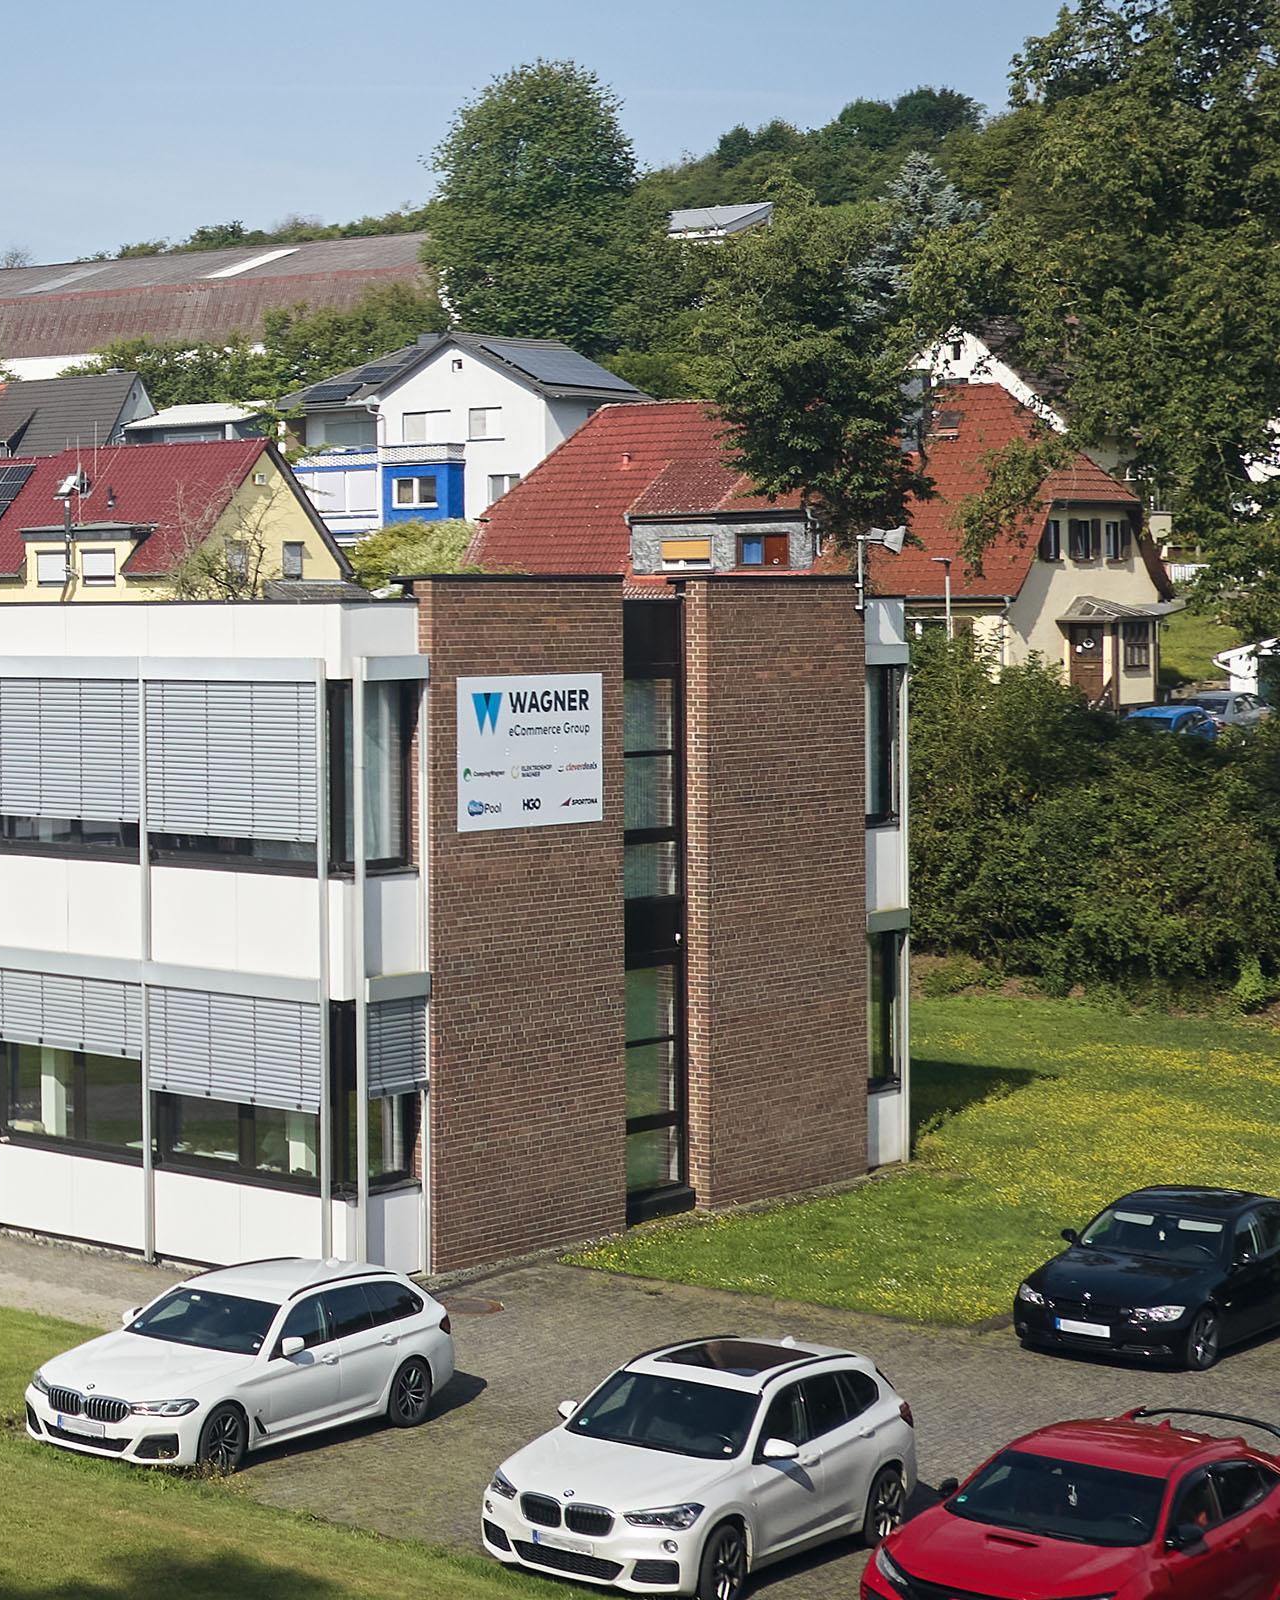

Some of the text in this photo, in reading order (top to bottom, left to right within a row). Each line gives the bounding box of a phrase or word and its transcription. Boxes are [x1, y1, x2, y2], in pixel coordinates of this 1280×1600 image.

[509, 689, 589, 713] WAGNER
[509, 722, 591, 738] eCommerce Group
[565, 761, 598, 772] cleverdeals
[522, 798, 541, 811] HGO
